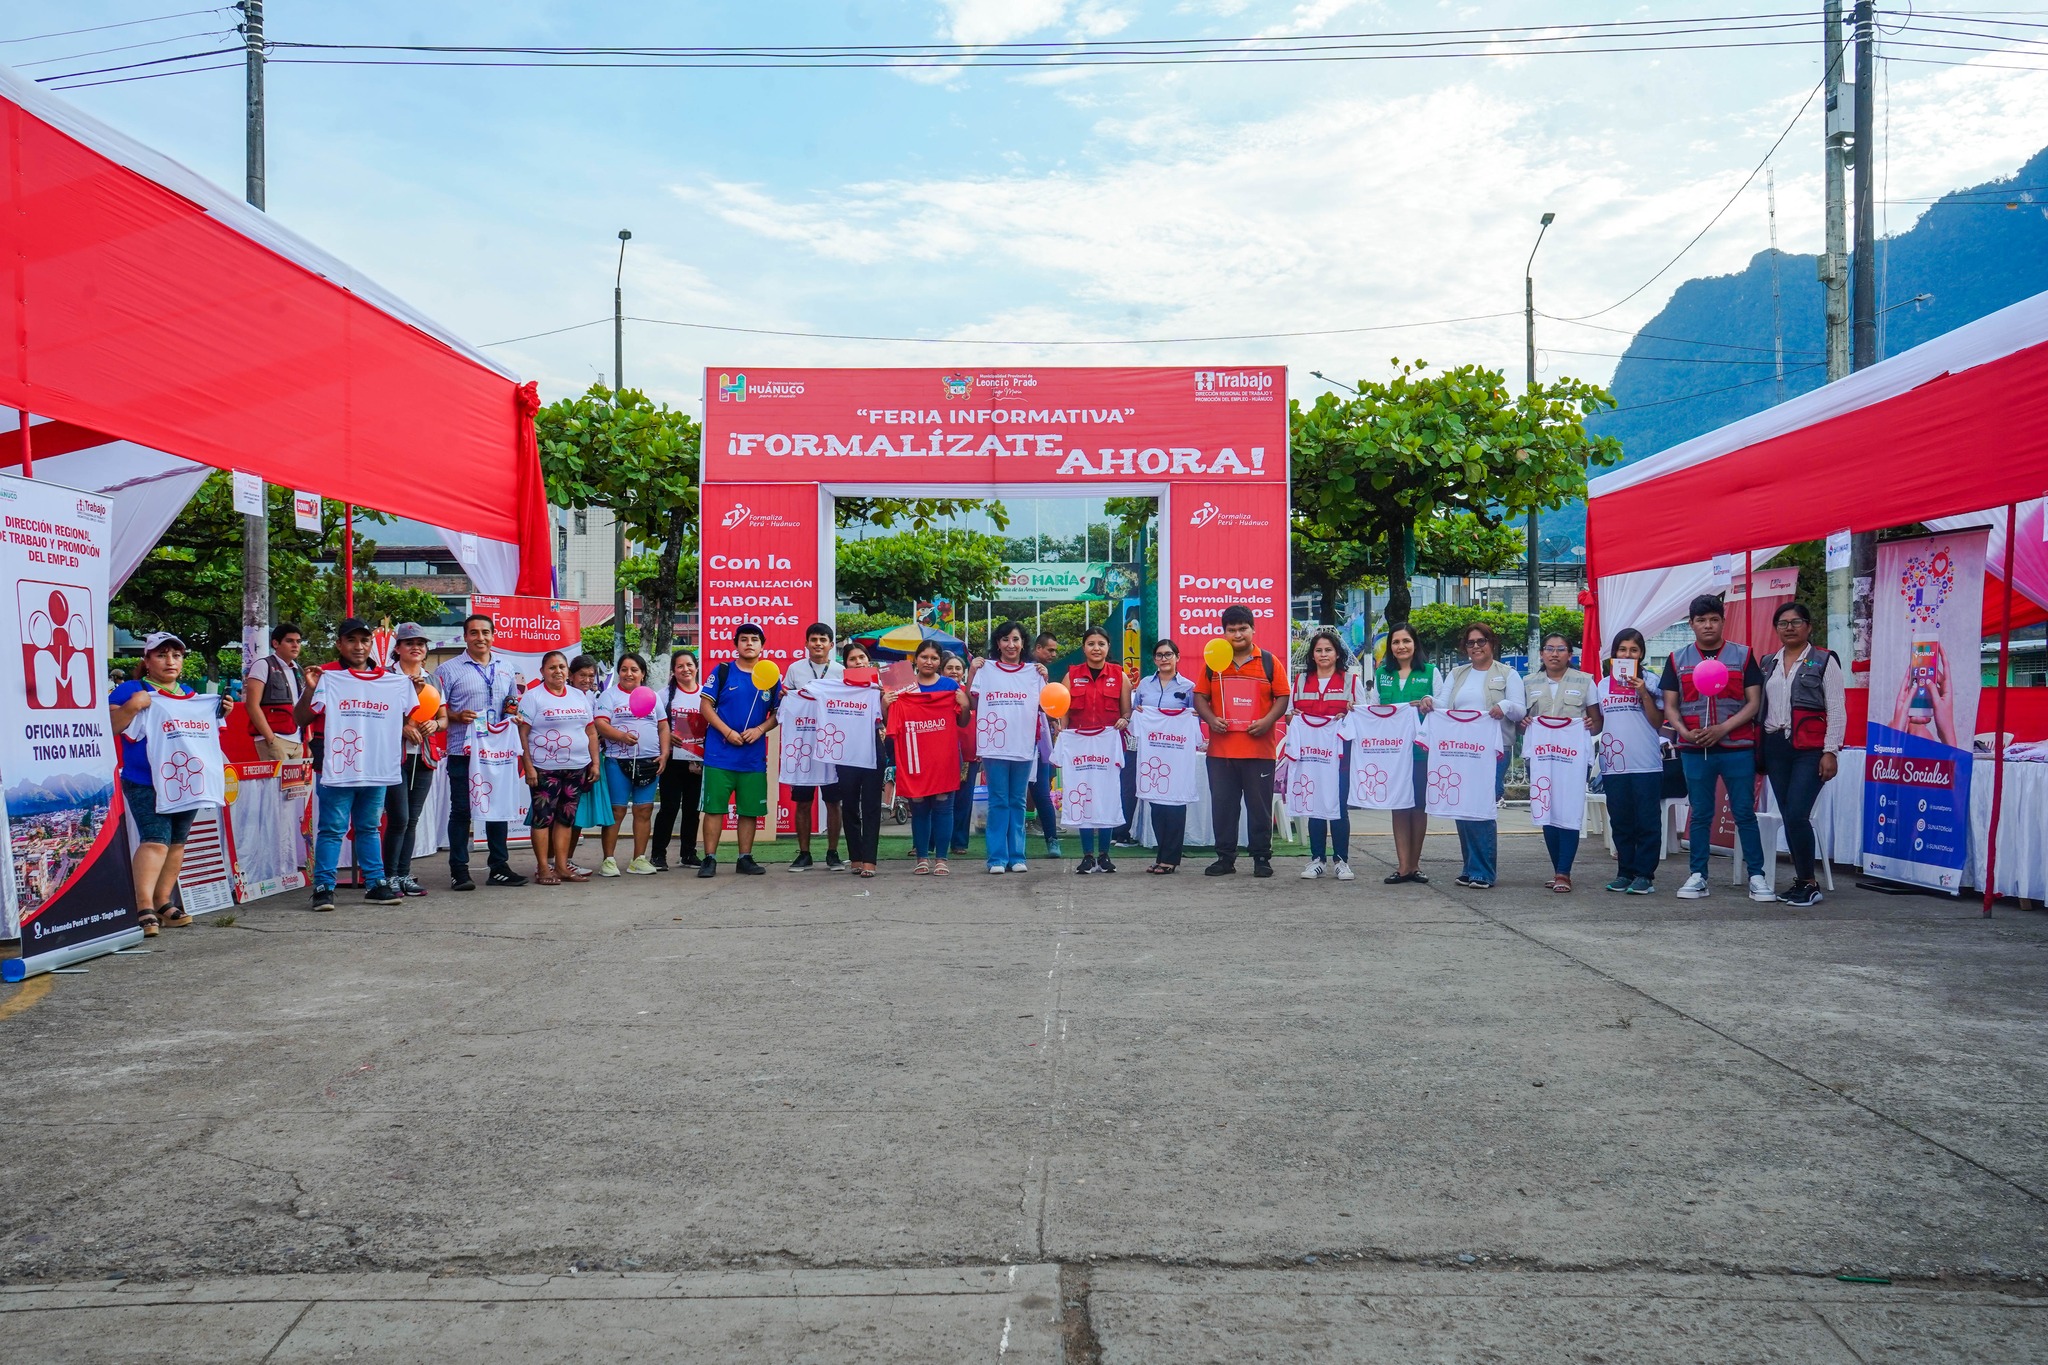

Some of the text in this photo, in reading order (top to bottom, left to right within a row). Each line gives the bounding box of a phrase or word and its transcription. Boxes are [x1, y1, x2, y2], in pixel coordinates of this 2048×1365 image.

[976, 378, 1038, 386] Leoncio Prado
[1216, 372, 1272, 390] Trabajo
[748, 384, 804, 394] HUÁNUCO
[857, 408, 1135, 424] “FERIA INFORMATIVA”
[728, 429, 1063, 457] ¡FORMALÍZATE
[1056, 448, 1265, 475] AHORA!
[85, 500, 106, 516] Trabajo
[6, 516, 91, 542] DIRECCIÓN REGIONAL
[9, 532, 48, 548] TRABAJO
[50, 538, 54, 549] Y
[58, 541, 100, 558] PROMOCIÓN
[29, 550, 78, 568] DEL EMPLEO
[710, 554, 792, 570] Con la
[710, 578, 812, 588] FORMALIZACIÓN
[1032, 571, 1080, 586] MARÍA
[1179, 575, 1274, 594] Porque
[482, 597, 500, 605] Trabajo
[710, 596, 794, 607] LABORAL
[1179, 595, 1272, 604] Formalizados
[492, 613, 560, 630] Formaliza
[710, 612, 799, 625] mejorás
[493, 629, 512, 639] Perú
[520, 630, 560, 640] Huánuco
[1179, 624, 1224, 635] todo
[710, 650, 786, 659] mera
[995, 692, 1027, 700] Trabajo
[351, 700, 389, 712] Trabajo
[836, 700, 868, 710] Trabajo
[174, 720, 210, 731] Trabajo
[915, 718, 946, 730] TRABAJO
[26, 723, 102, 740] OFICINA ZONAL
[1372, 738, 1404, 748] Trabajo
[1450, 740, 1486, 752] Trabajo
[33, 740, 101, 760] TINGO MARÍA
[1872, 758, 1950, 784] Redes Sociales
[43, 928, 51, 936] Av.
[52, 922, 72, 933] Alameda
[72, 916, 84, 928] Perú
[90, 914, 100, 923] 550
[102, 912, 114, 920] Tingo
